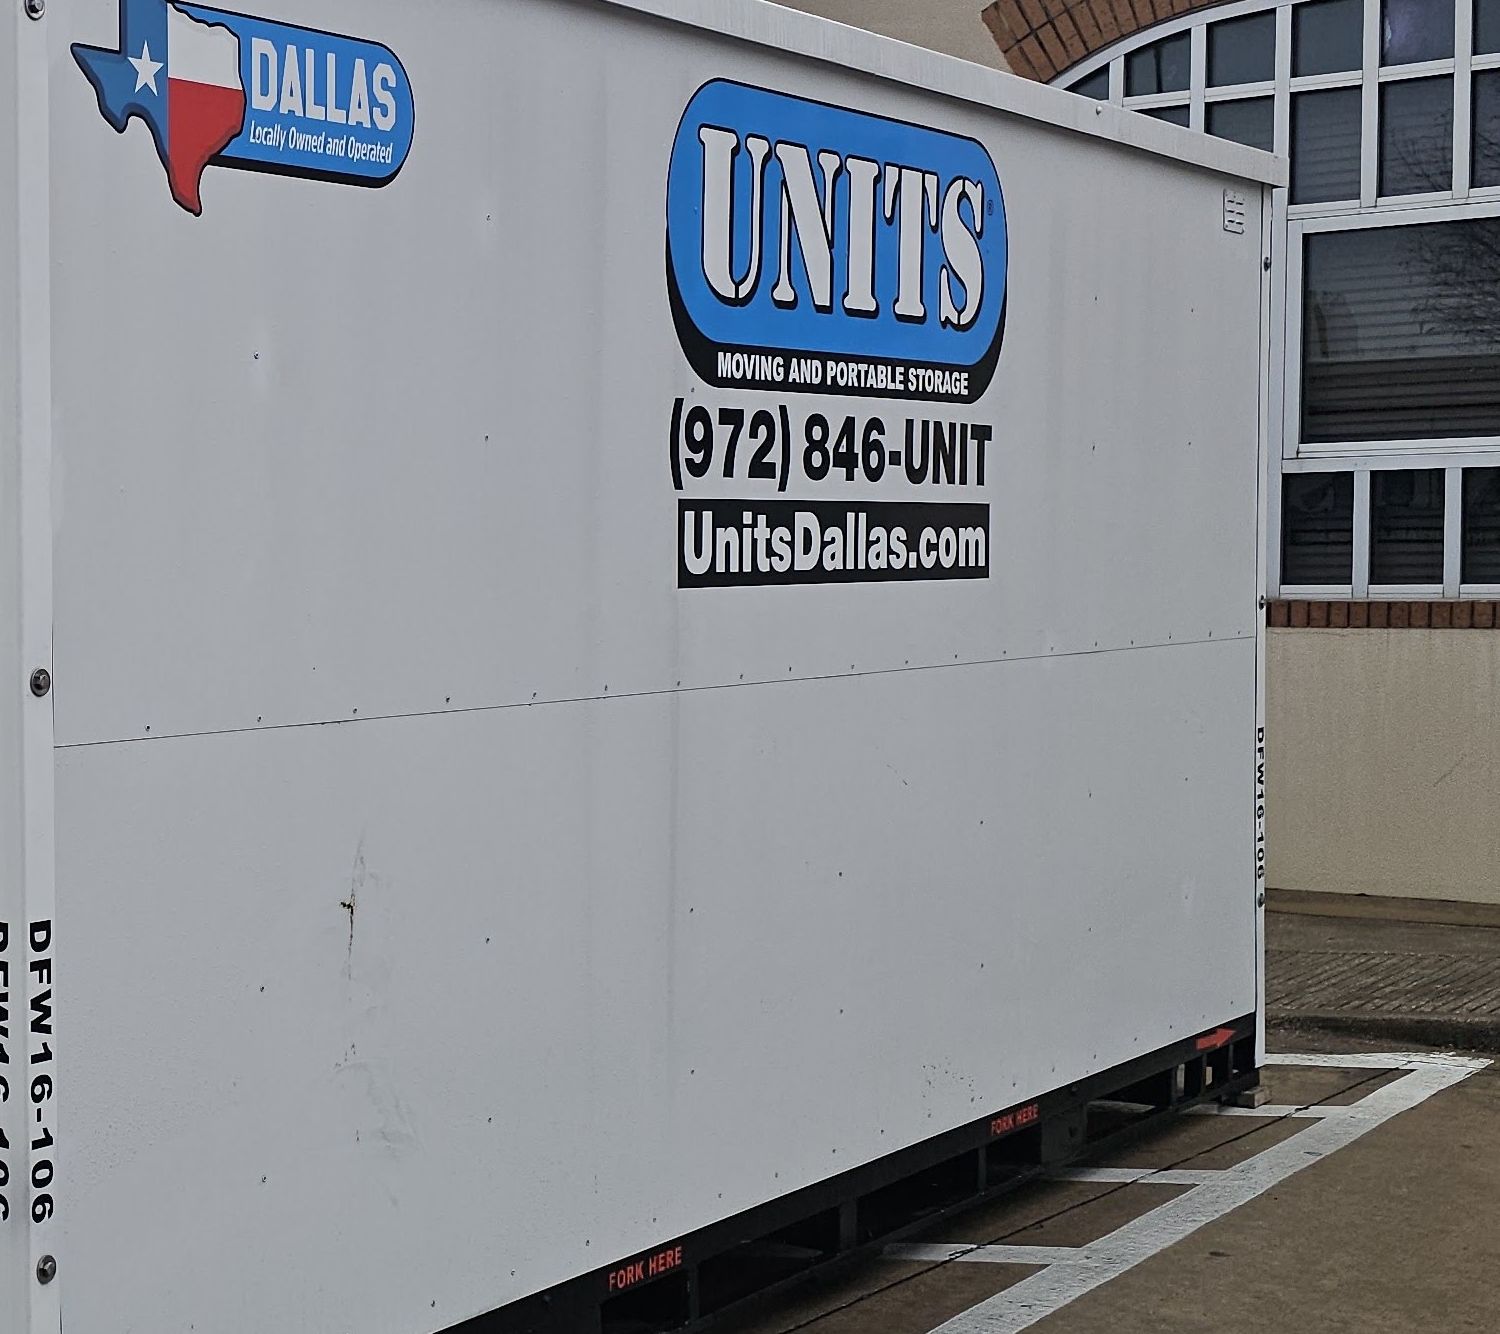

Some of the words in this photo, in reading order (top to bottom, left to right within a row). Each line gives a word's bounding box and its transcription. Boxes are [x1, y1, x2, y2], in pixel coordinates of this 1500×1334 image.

[250, 36, 397, 132] DALLAS
[250, 120, 287, 151] Locally
[288, 126, 325, 154] Owned
[326, 135, 346, 157] and
[347, 136, 394, 164] Operated
[717, 351, 784, 383] MOVING
[788, 358, 821, 385] AND
[826, 361, 904, 392] PORTABLE
[908, 368, 969, 396] STORAGE
[669, 398, 791, 492] (972)
[803, 413, 993, 486] 846-UNIT
[683, 509, 986, 575] UnitsDallas.com
[1256, 726, 1265, 880] DFW16-106
[29, 919, 54, 1224] DFW16-106
[991, 1113, 1014, 1136] FORK
[609, 1260, 644, 1292] FORK
[649, 1246, 683, 1276] HERE
